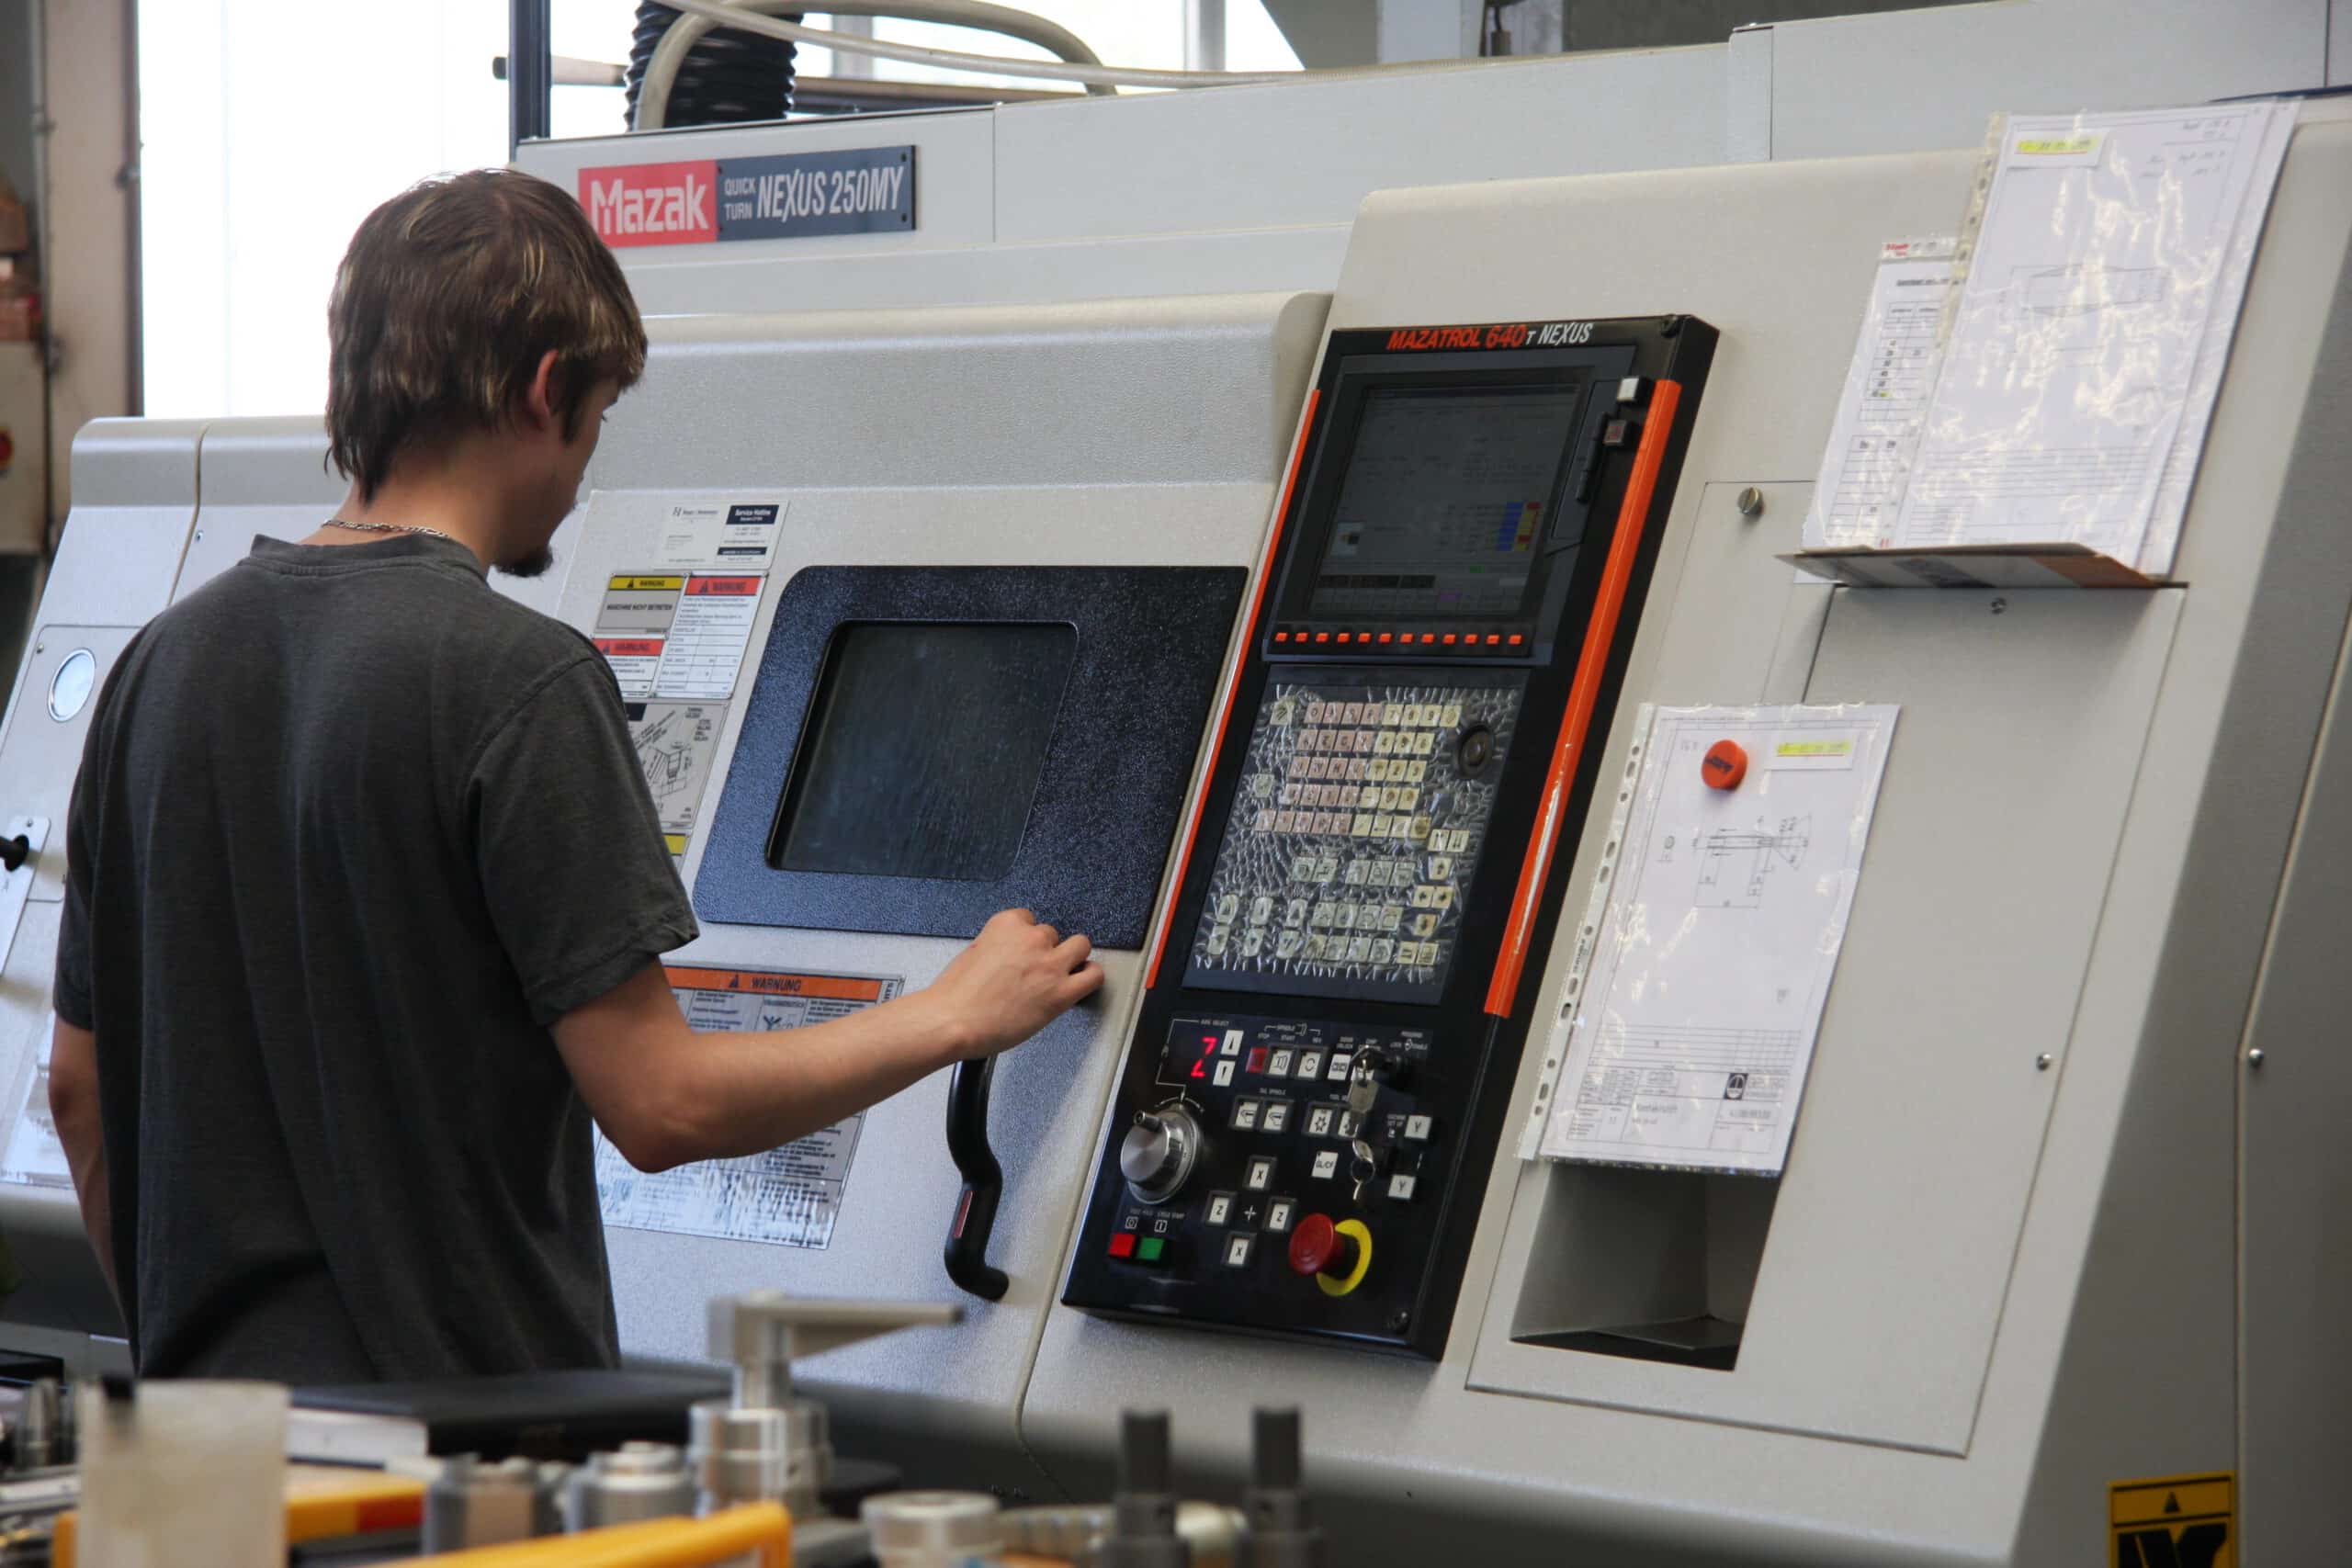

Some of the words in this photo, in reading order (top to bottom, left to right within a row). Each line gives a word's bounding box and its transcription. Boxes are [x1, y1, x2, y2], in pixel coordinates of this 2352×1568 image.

[724, 177, 756, 196] QUICK
[757, 169, 826, 222] NEXUS
[830, 166, 905, 215] 250MY
[591, 174, 708, 235] Mazak
[724, 203, 752, 220] TURN
[1386, 328, 1481, 350] MAZATROL
[1538, 321, 1594, 345] NEXUS
[752, 976, 802, 992] WARNUNG
[1415, 1121, 1422, 1133] Y
[1256, 1168, 1265, 1181] X
[1398, 1179, 1408, 1192] Y
[1216, 1204, 1224, 1216] Z
[1276, 1211, 1284, 1223] Z
[1235, 1246, 1244, 1258] X
